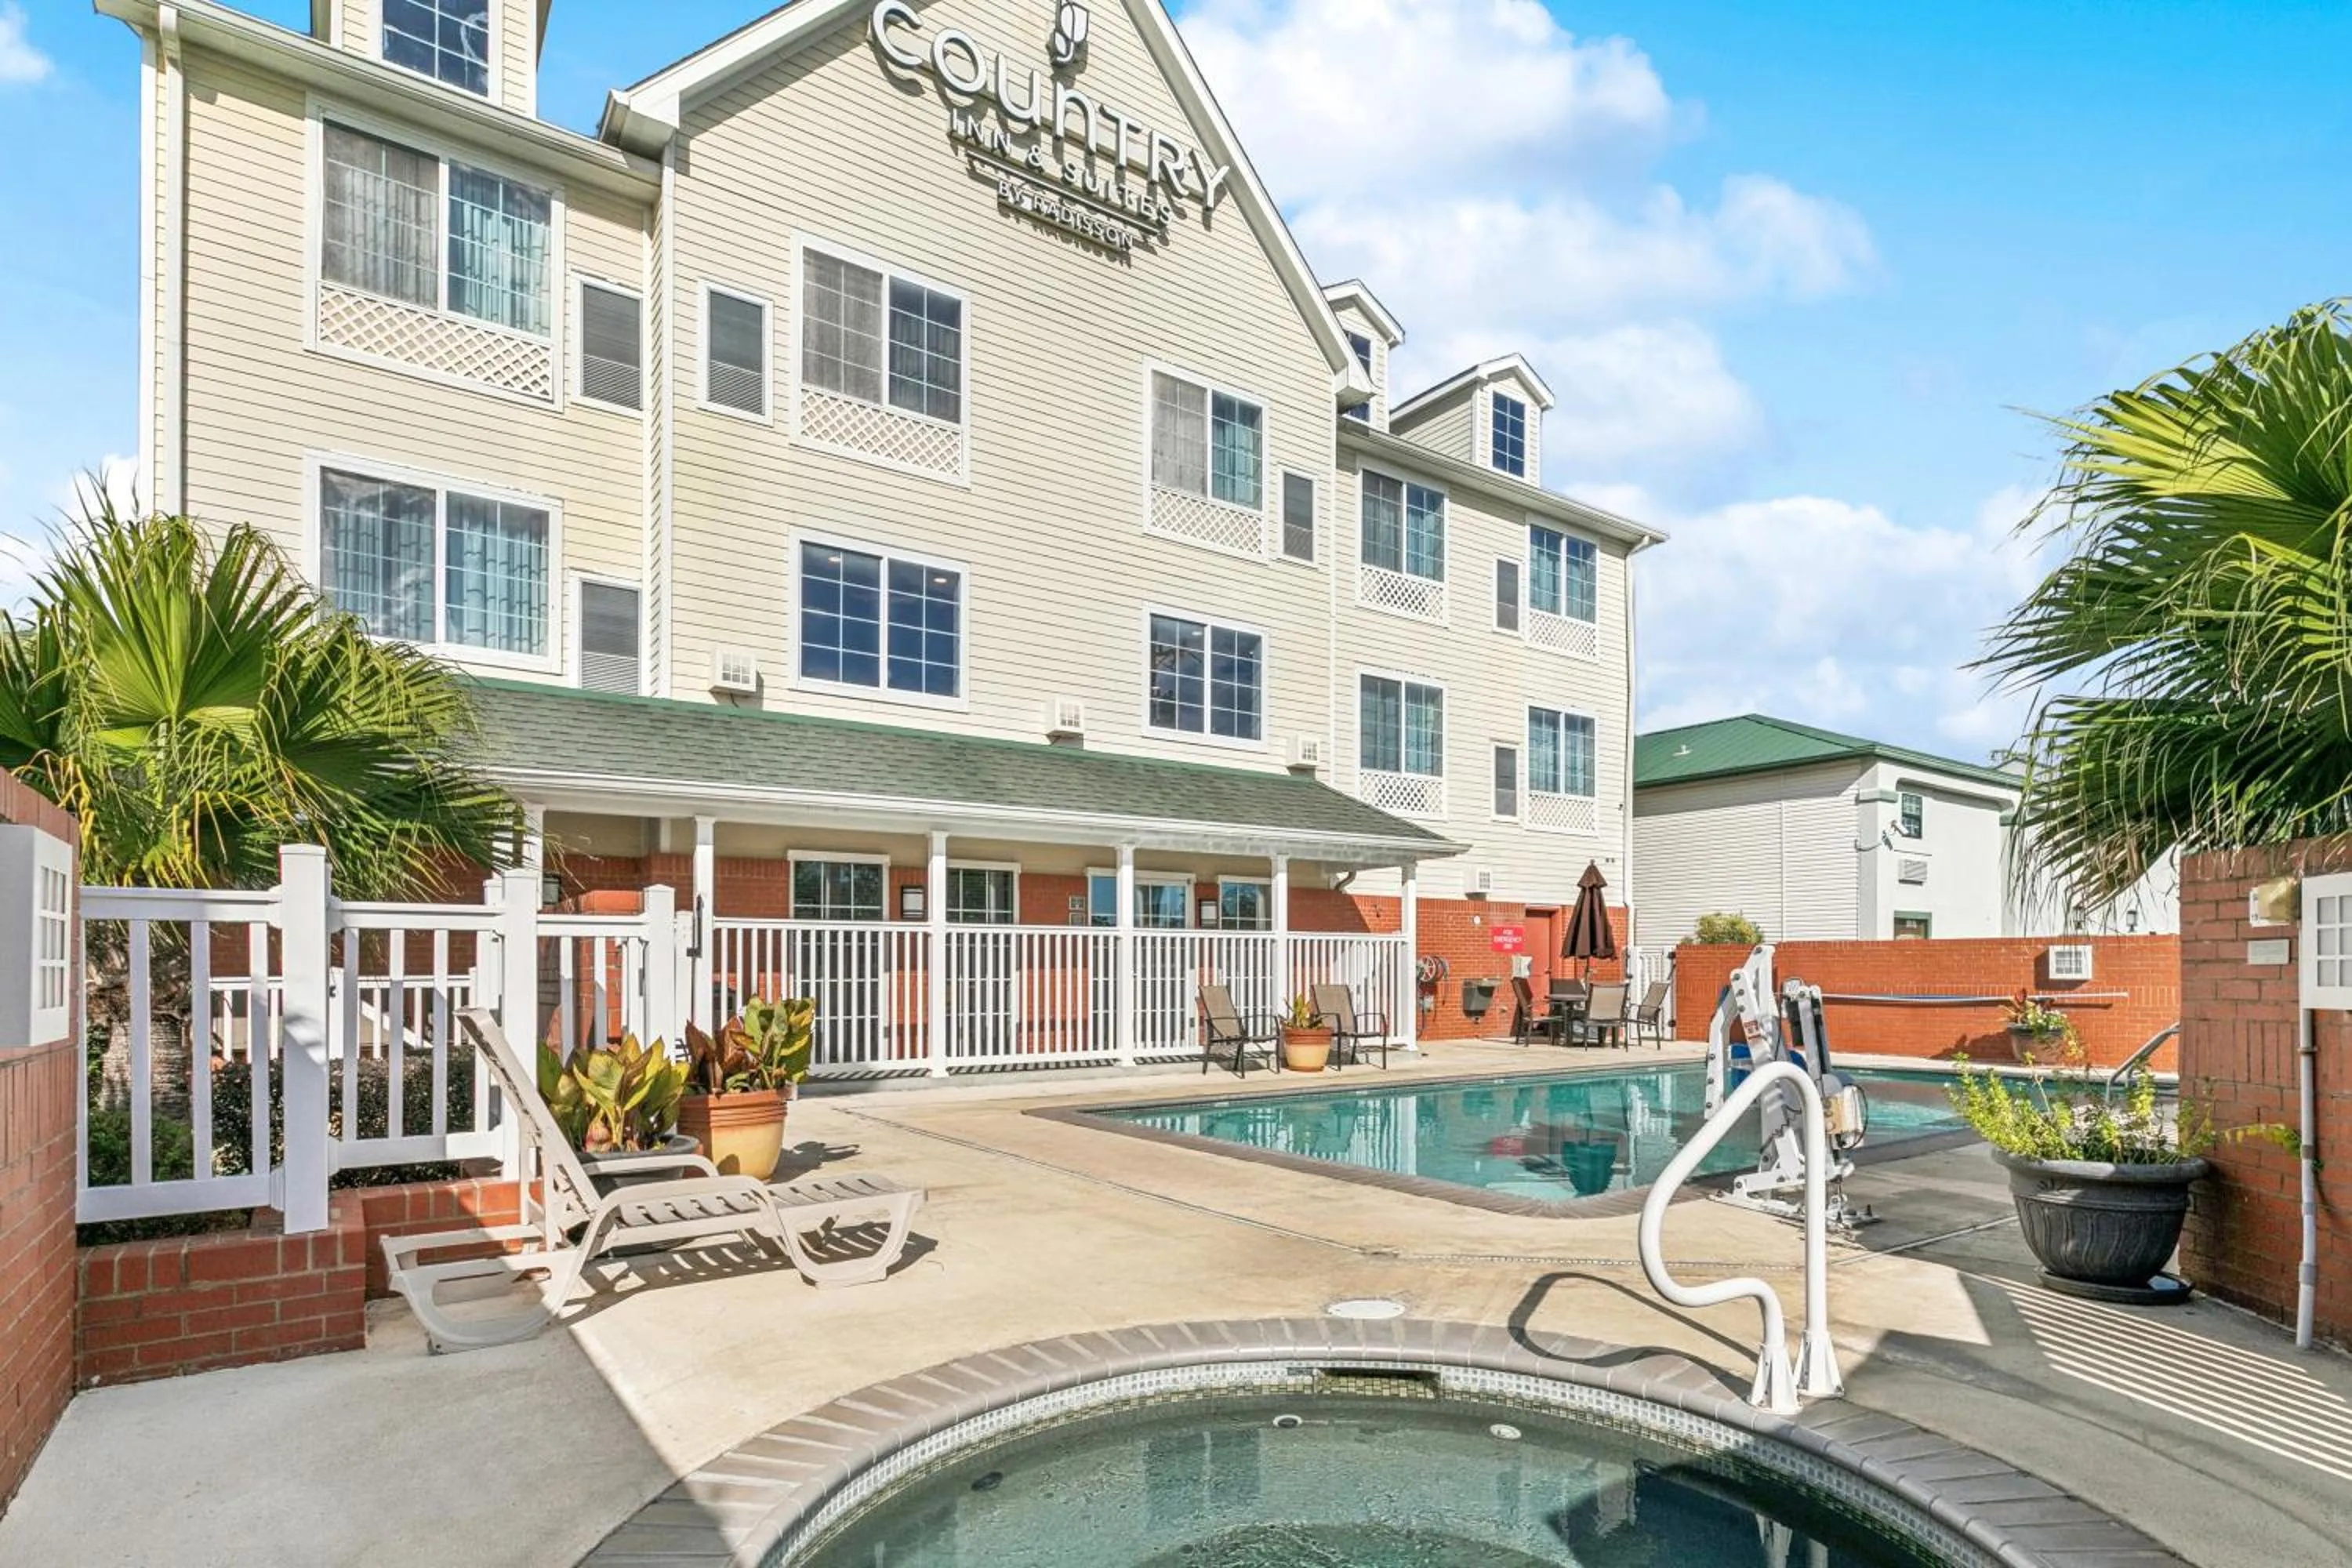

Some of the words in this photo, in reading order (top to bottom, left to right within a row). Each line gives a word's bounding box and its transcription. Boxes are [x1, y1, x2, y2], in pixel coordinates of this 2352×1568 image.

[950, 107, 1012, 157] INN
[1026, 145, 1045, 168] &
[1063, 161, 1174, 227] SUITES
[997, 179, 1022, 204] BY
[1033, 194, 1134, 250] RADISSON
